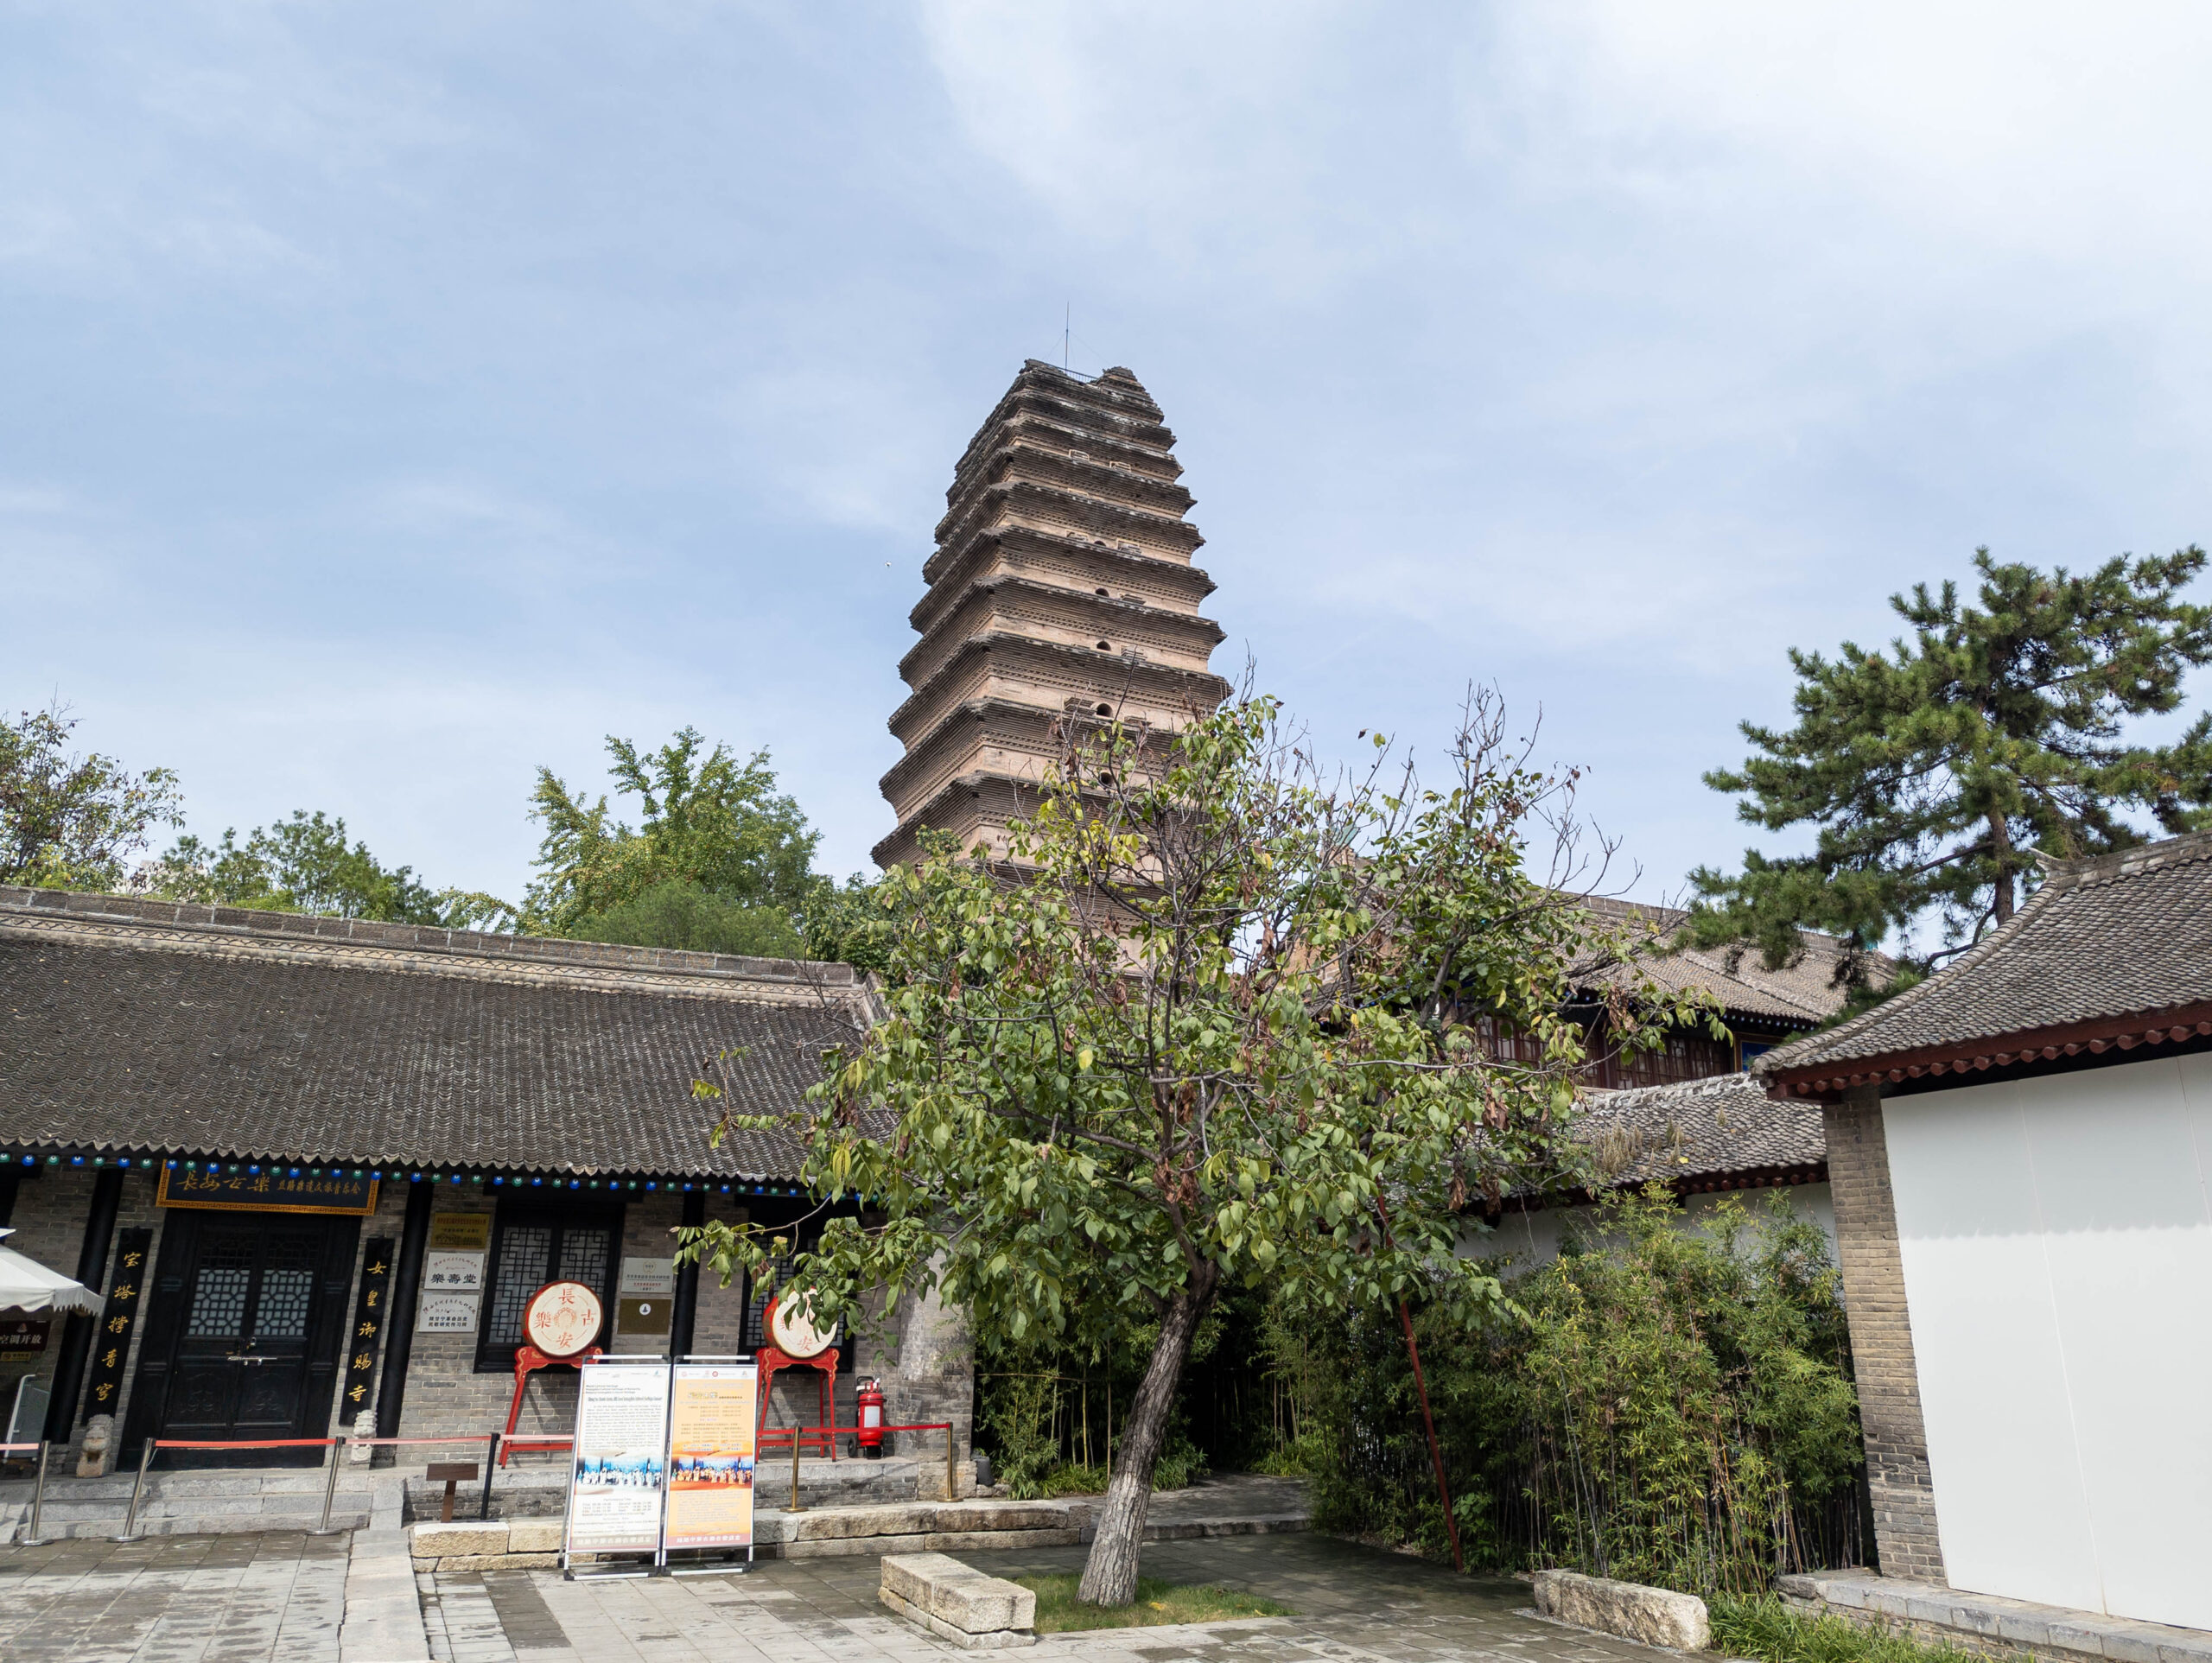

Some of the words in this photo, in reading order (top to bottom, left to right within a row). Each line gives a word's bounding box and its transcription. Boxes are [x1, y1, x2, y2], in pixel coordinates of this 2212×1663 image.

[430, 1273, 477, 1284] 樂壽堂
[558, 1288, 575, 1304] 長
[533, 1311, 552, 1329] 樂
[581, 1309, 596, 1326] 古
[556, 1331, 573, 1349] 安
